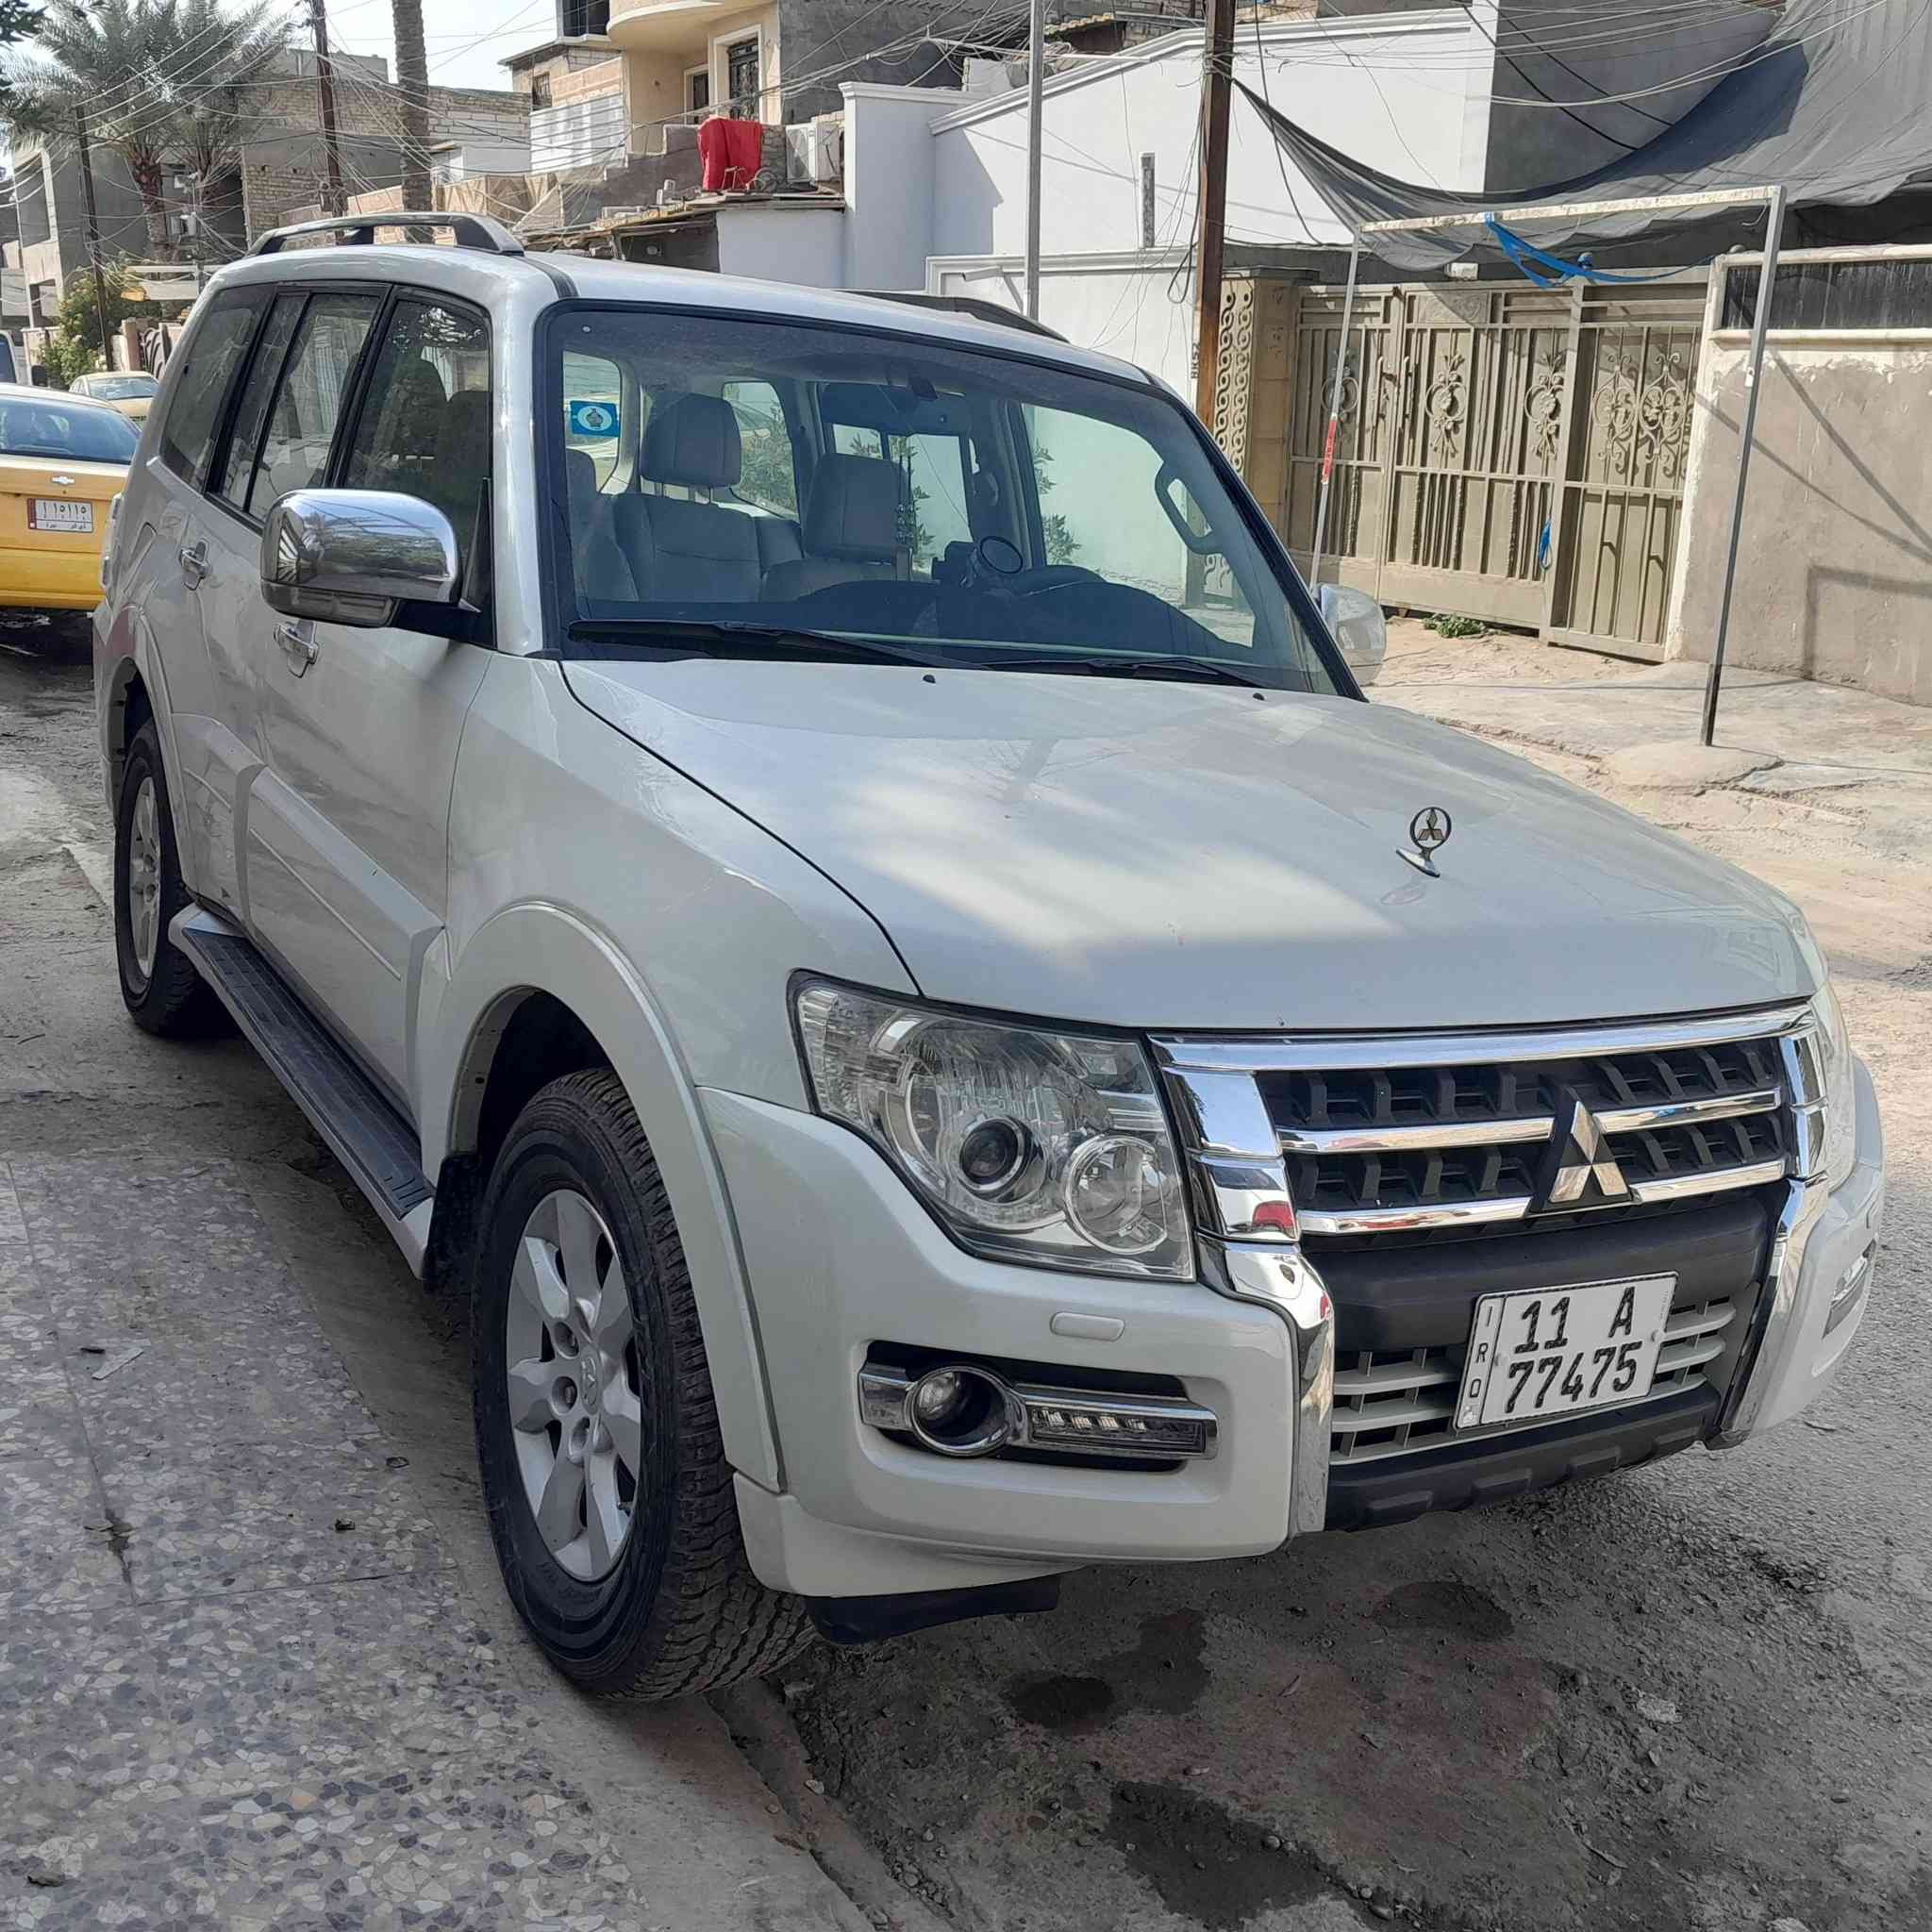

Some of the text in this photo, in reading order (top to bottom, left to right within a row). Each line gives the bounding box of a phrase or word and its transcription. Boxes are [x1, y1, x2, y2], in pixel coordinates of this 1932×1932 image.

[1514, 1296, 1570, 1354] 11
[1607, 1286, 1636, 1338] A
[1505, 1341, 1643, 1413] 77475
